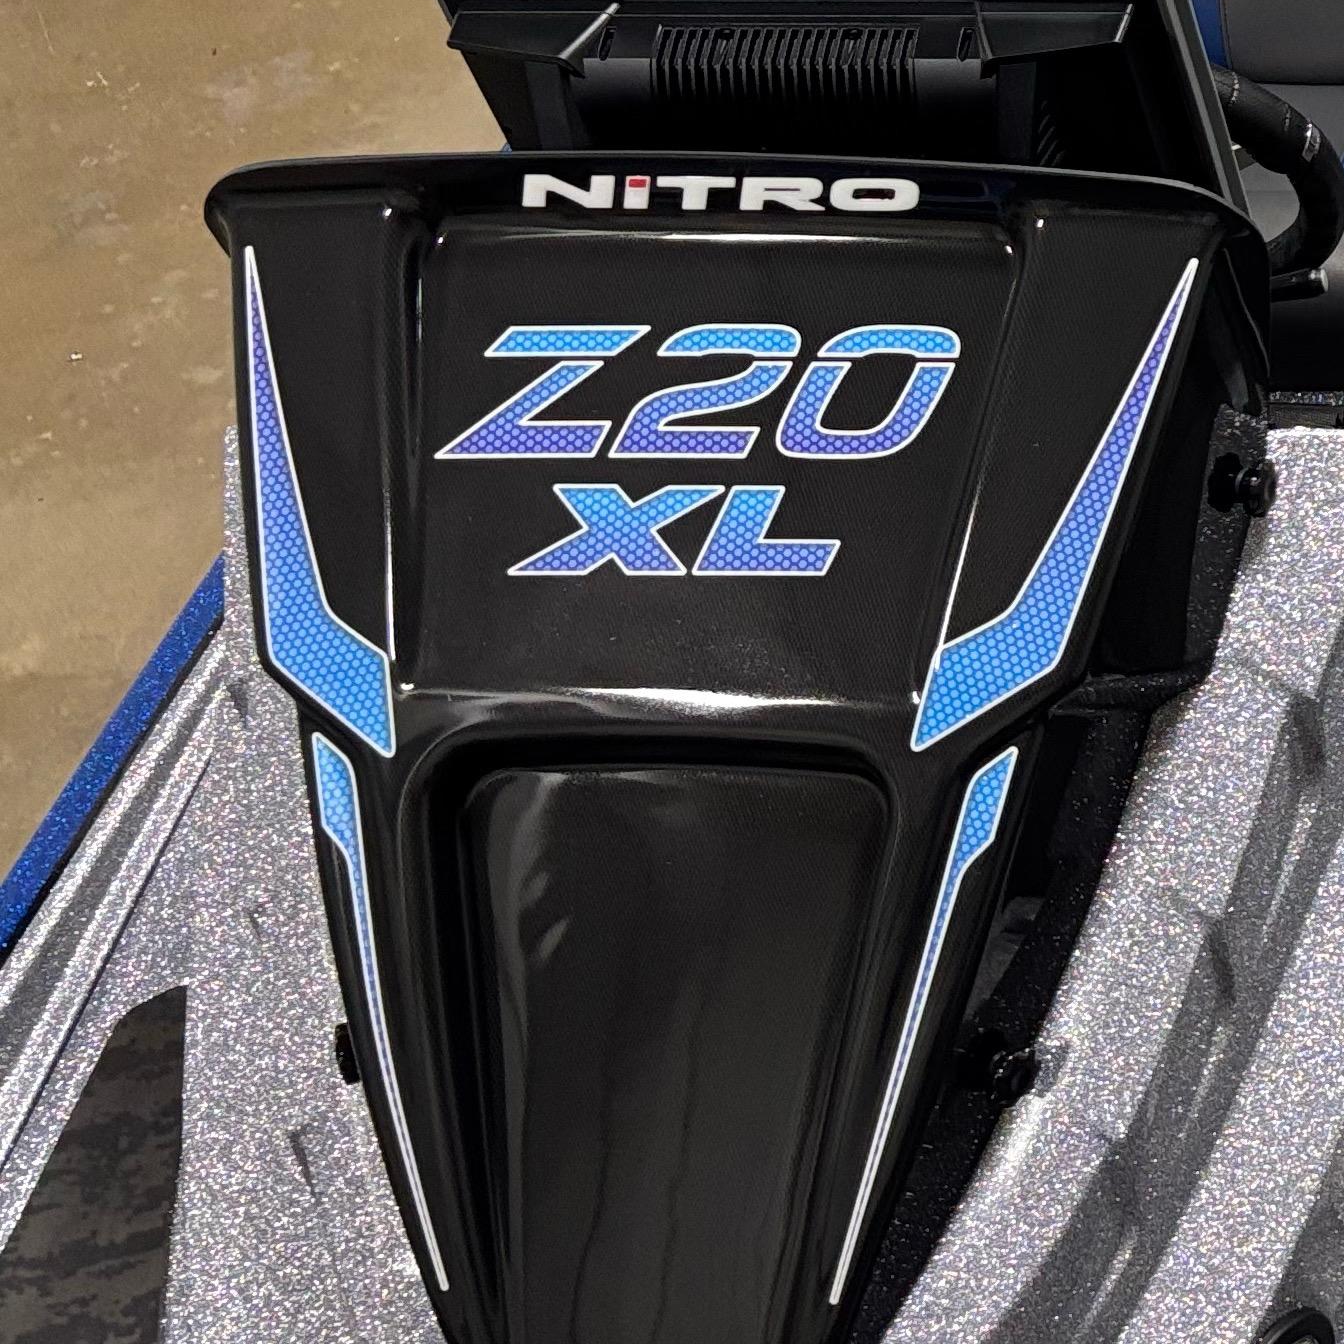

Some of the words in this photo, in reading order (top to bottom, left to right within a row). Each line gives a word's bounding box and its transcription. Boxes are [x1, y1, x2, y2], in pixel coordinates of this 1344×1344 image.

[521, 173, 920, 212] NITRO
[434, 323, 961, 459] Z20
[507, 483, 840, 576] XL
